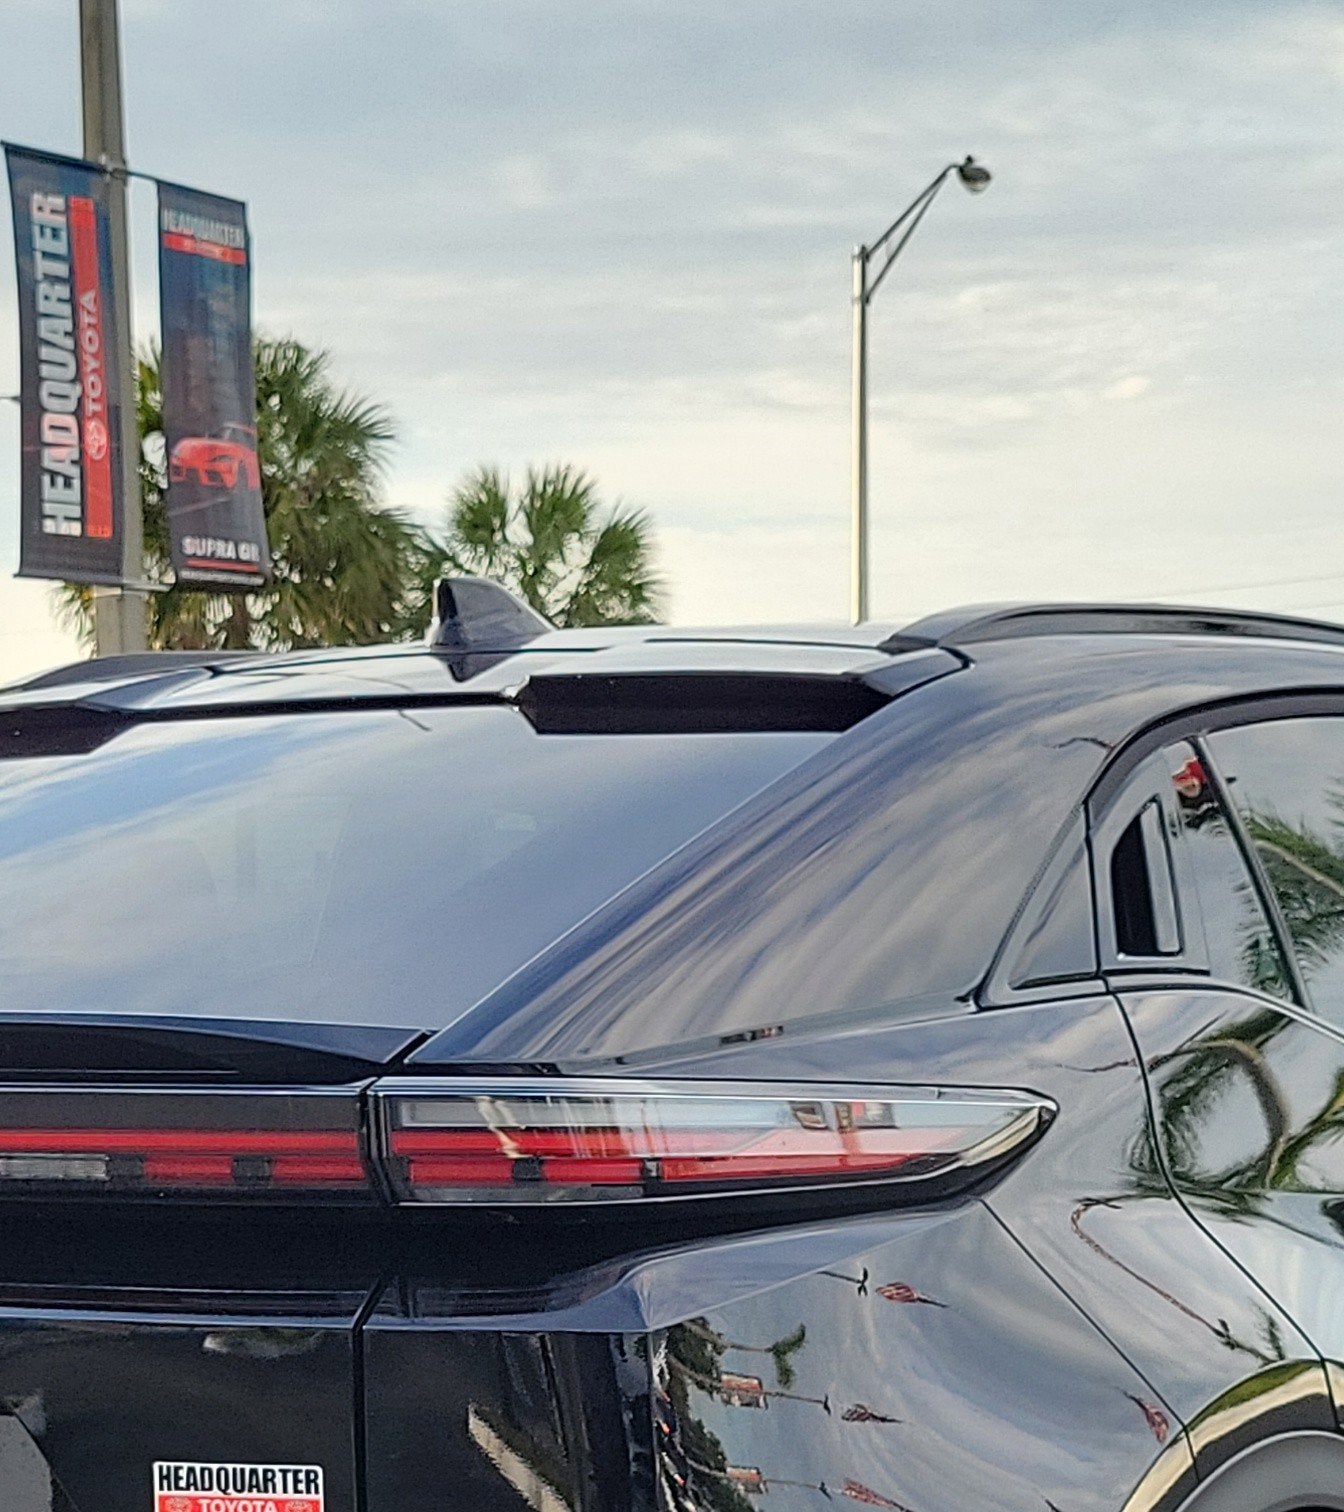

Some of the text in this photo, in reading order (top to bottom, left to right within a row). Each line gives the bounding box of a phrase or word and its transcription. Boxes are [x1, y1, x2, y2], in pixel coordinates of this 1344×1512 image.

[30, 193, 82, 537] HEADQUARTER
[80, 291, 103, 414] TOYOTA
[181, 535, 236, 559] SUPRA
[158, 1464, 320, 1495] HEADQUARTER
